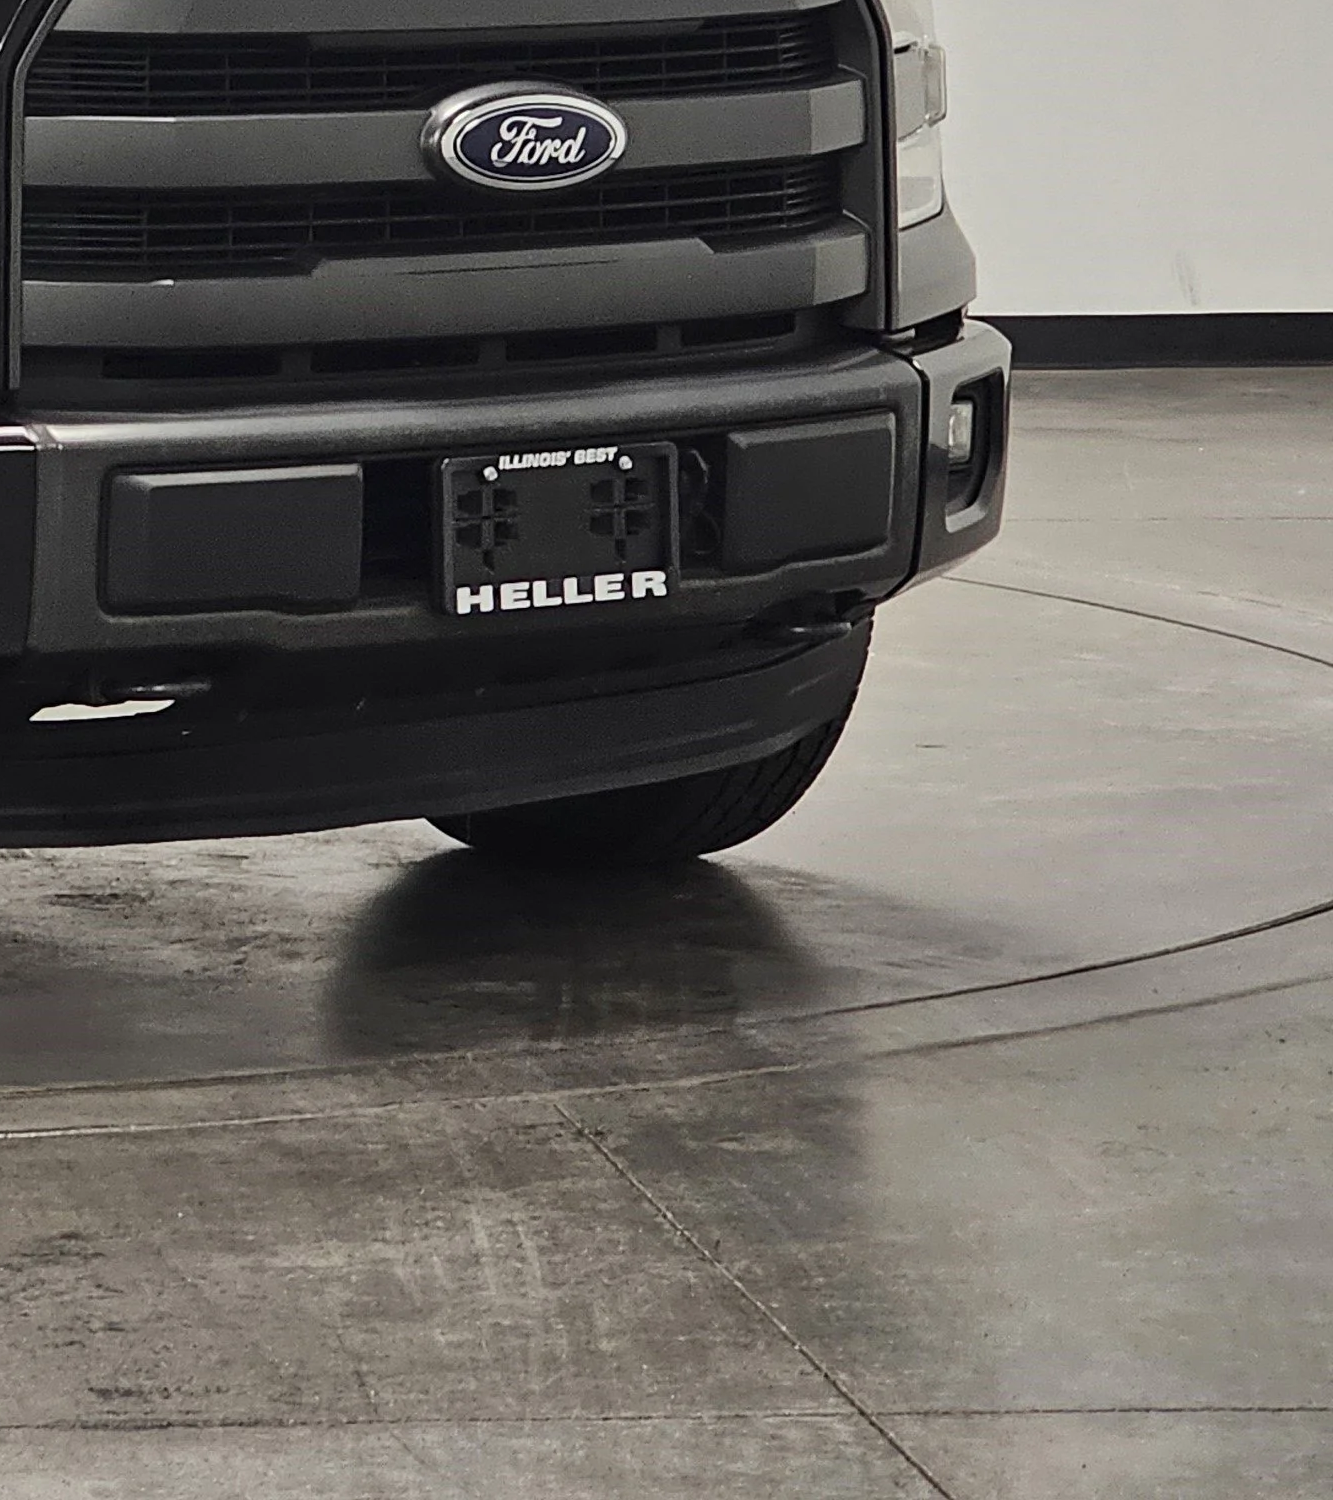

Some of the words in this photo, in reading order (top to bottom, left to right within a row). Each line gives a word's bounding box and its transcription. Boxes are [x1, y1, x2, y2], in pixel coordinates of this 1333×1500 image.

[491, 115, 586, 167] Ford
[573, 447, 618, 465] BEST
[456, 570, 667, 615] HELLER
